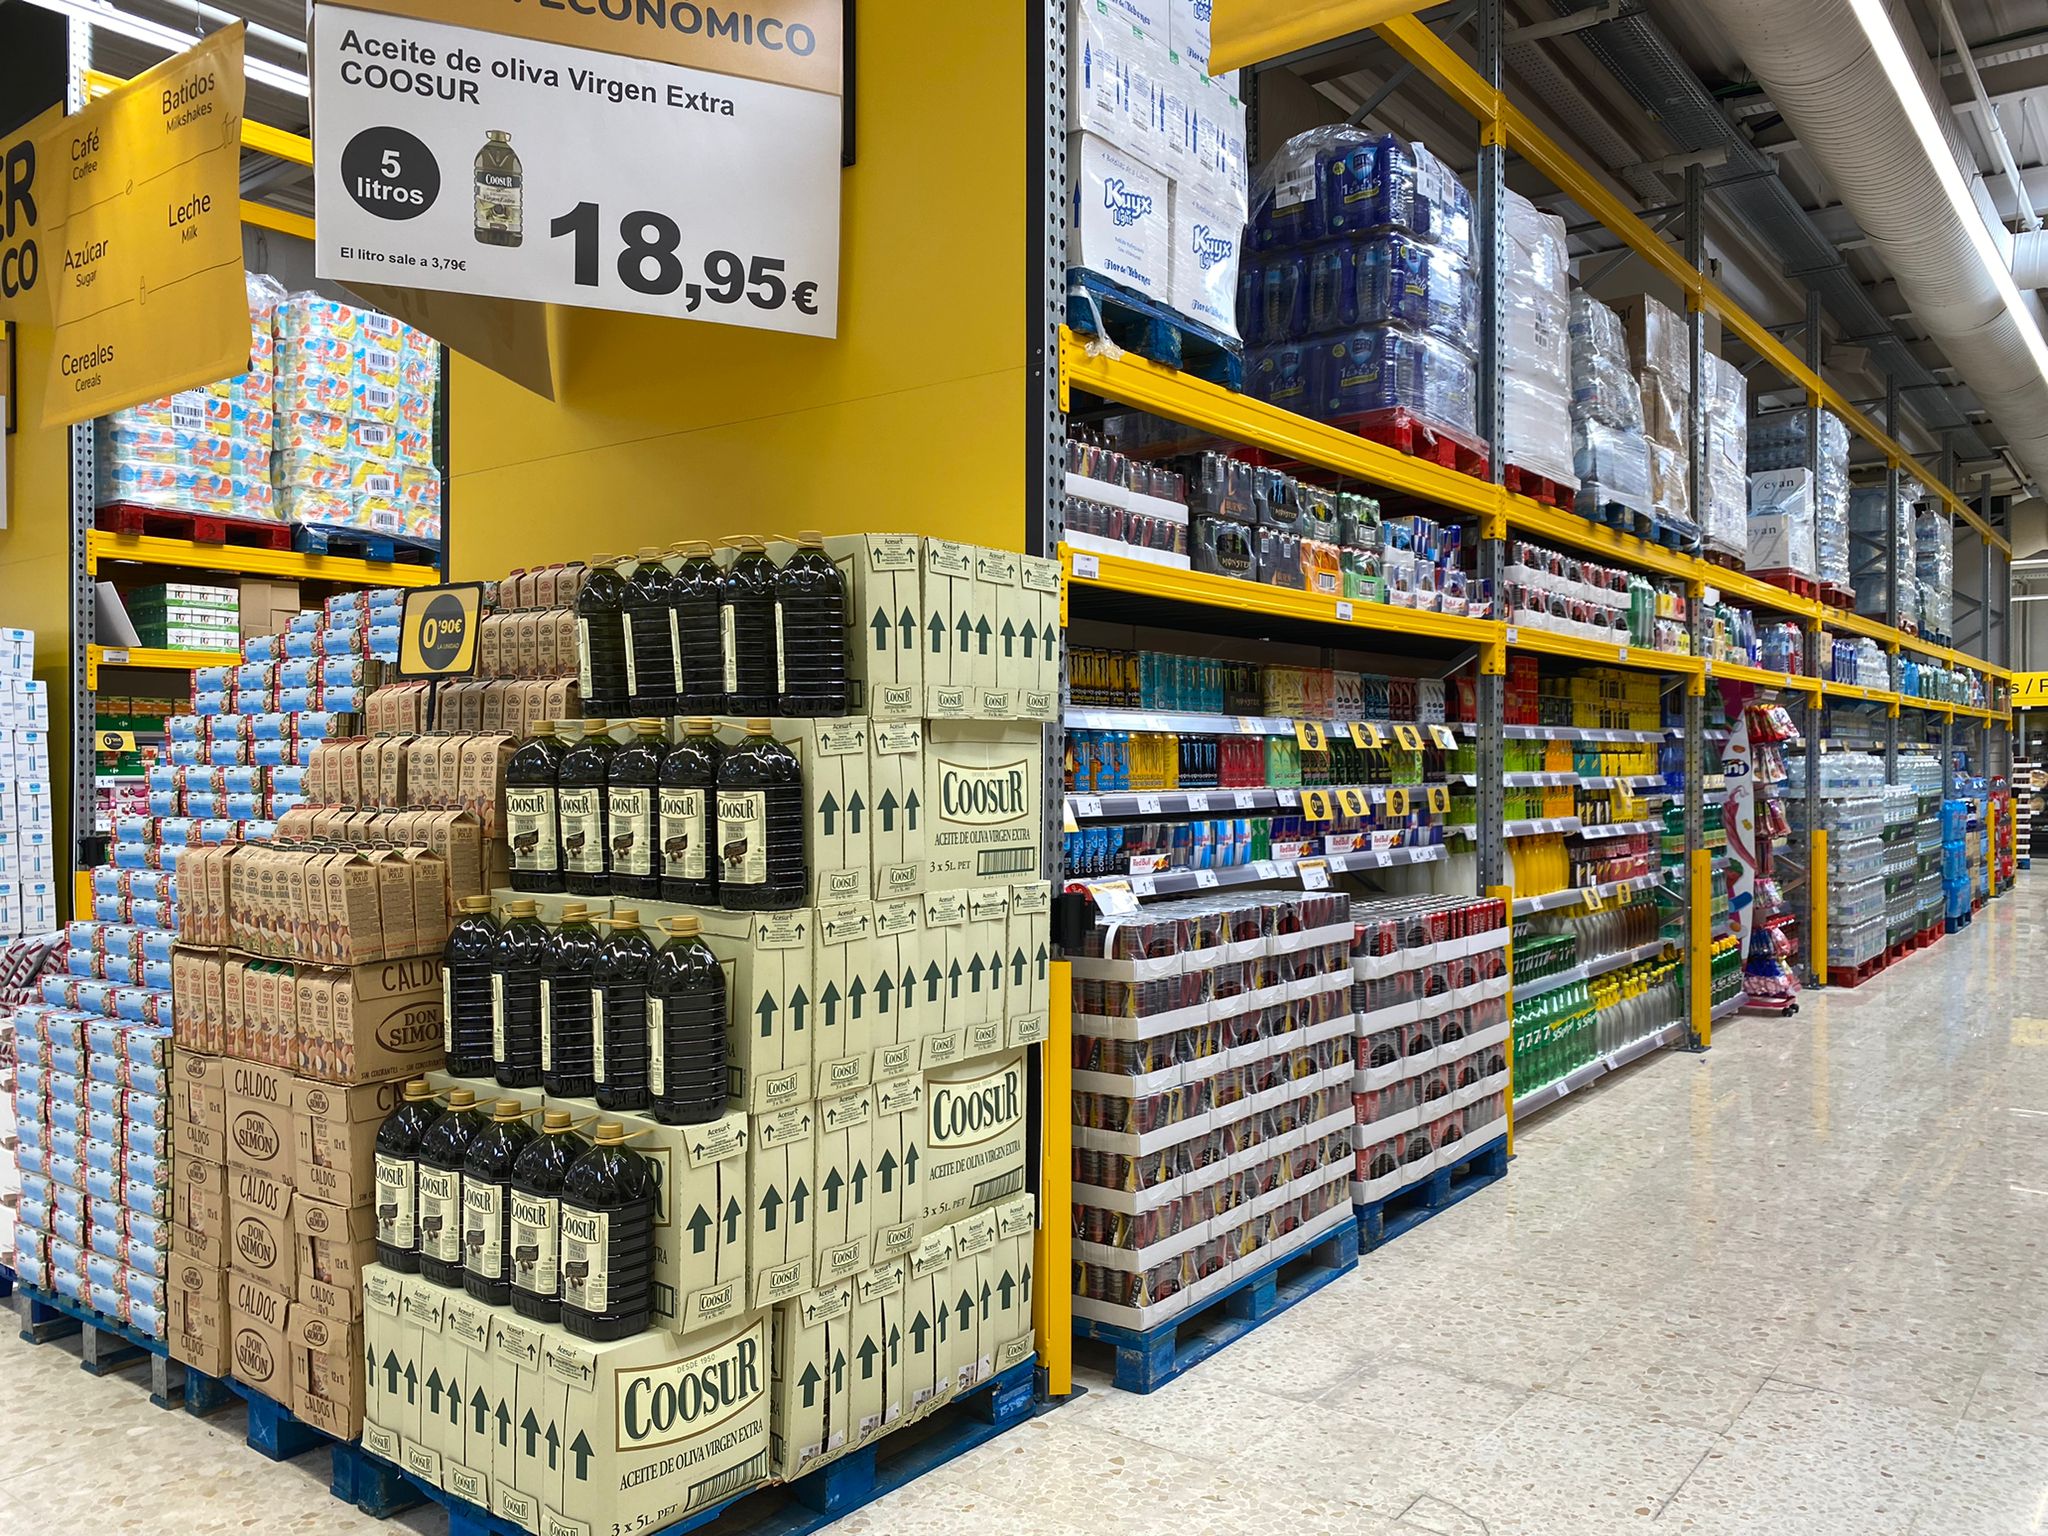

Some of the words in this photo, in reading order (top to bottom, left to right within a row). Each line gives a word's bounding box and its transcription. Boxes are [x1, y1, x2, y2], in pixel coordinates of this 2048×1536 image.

[340, 29, 436, 66] Aceite
[446, 49, 481, 74] de
[491, 58, 559, 87] oliva
[568, 67, 657, 103] Virgen
[667, 84, 735, 116] Extra
[340, 61, 481, 105] COOSUR
[162, 73, 215, 115] Batidos
[166, 102, 212, 134] Milkshakes
[71, 127, 99, 161] Café
[72, 160, 97, 180] Coffee
[380, 149, 402, 178] 5
[357, 177, 424, 205] litros
[485, 174, 512, 187] COOSUR
[168, 193, 211, 227] Leche
[1104, 178, 1152, 219] Kuyx
[181, 226, 198, 244] Milk
[64, 239, 108, 272] Azúcar
[340, 247, 353, 259] El
[358, 249, 385, 262] litro
[389, 254, 416, 266] sale
[420, 258, 428, 267] a
[432, 257, 467, 271] 3,79€
[76, 270, 97, 288] Sugar
[61, 344, 113, 376] Cereales
[75, 373, 101, 392] Cereals
[1764, 479, 1794, 490] cyan
[506, 794, 546, 814] COOSUR
[609, 794, 640, 814] COOSUR
[943, 770, 1024, 816] COOSUR
[660, 795, 694, 816] COOSUR
[718, 799, 754, 819] COOSUR
[934, 832, 958, 846] ACEITE
[960, 832, 970, 845] DE
[970, 830, 989, 844] OLIVA
[989, 829, 1012, 843] VIRGEN
[1012, 828, 1030, 841] EXTRA
[930, 861, 935, 872] 3
[957, 861, 971, 870] PET
[382, 959, 443, 991] CALDO
[404, 1009, 437, 1026] DON
[234, 1069, 277, 1102] CALDOS
[933, 1070, 1019, 1140] COOSUR
[187, 1126, 209, 1146] CALDOS
[246, 1118, 265, 1134] DON
[239, 1128, 273, 1154] SIMON
[929, 1160, 955, 1181] ACEITE
[955, 1158, 966, 1173] DE
[965, 1152, 986, 1171] OLIVA
[985, 1144, 1006, 1166] VIRGEN
[1005, 1139, 1021, 1157] EXTRA
[310, 1168, 336, 1188] CALDOS
[240, 1174, 279, 1211] CALDOS
[511, 1197, 547, 1227] COOSUR
[922, 1206, 929, 1218] 3
[930, 1208, 937, 1216] x
[952, 1197, 966, 1209] PET
[248, 1224, 264, 1241] DON
[241, 1235, 271, 1263] SIMON
[771, 1266, 799, 1287] COOSUR
[238, 1284, 276, 1325] CALDOS
[310, 1284, 335, 1306] CALDOS
[702, 1289, 730, 1309] COOSUR
[181, 1335, 204, 1356] CALDOS
[245, 1335, 262, 1355] DON
[239, 1347, 268, 1377] SIMON
[677, 1360, 698, 1374] DESDE
[700, 1353, 716, 1366] 1950
[624, 1337, 759, 1440] COOSUR
[304, 1395, 330, 1418] CALDOS
[620, 1463, 658, 1491] ACEITE
[659, 1459, 674, 1475] DE
[676, 1448, 705, 1470] OLIVA
[705, 1430, 738, 1457] VIRGEN
[738, 1418, 763, 1443] EXTRA
[611, 1522, 621, 1536] 3
[624, 1522, 633, 1533] x
[657, 1503, 678, 1521] PET
